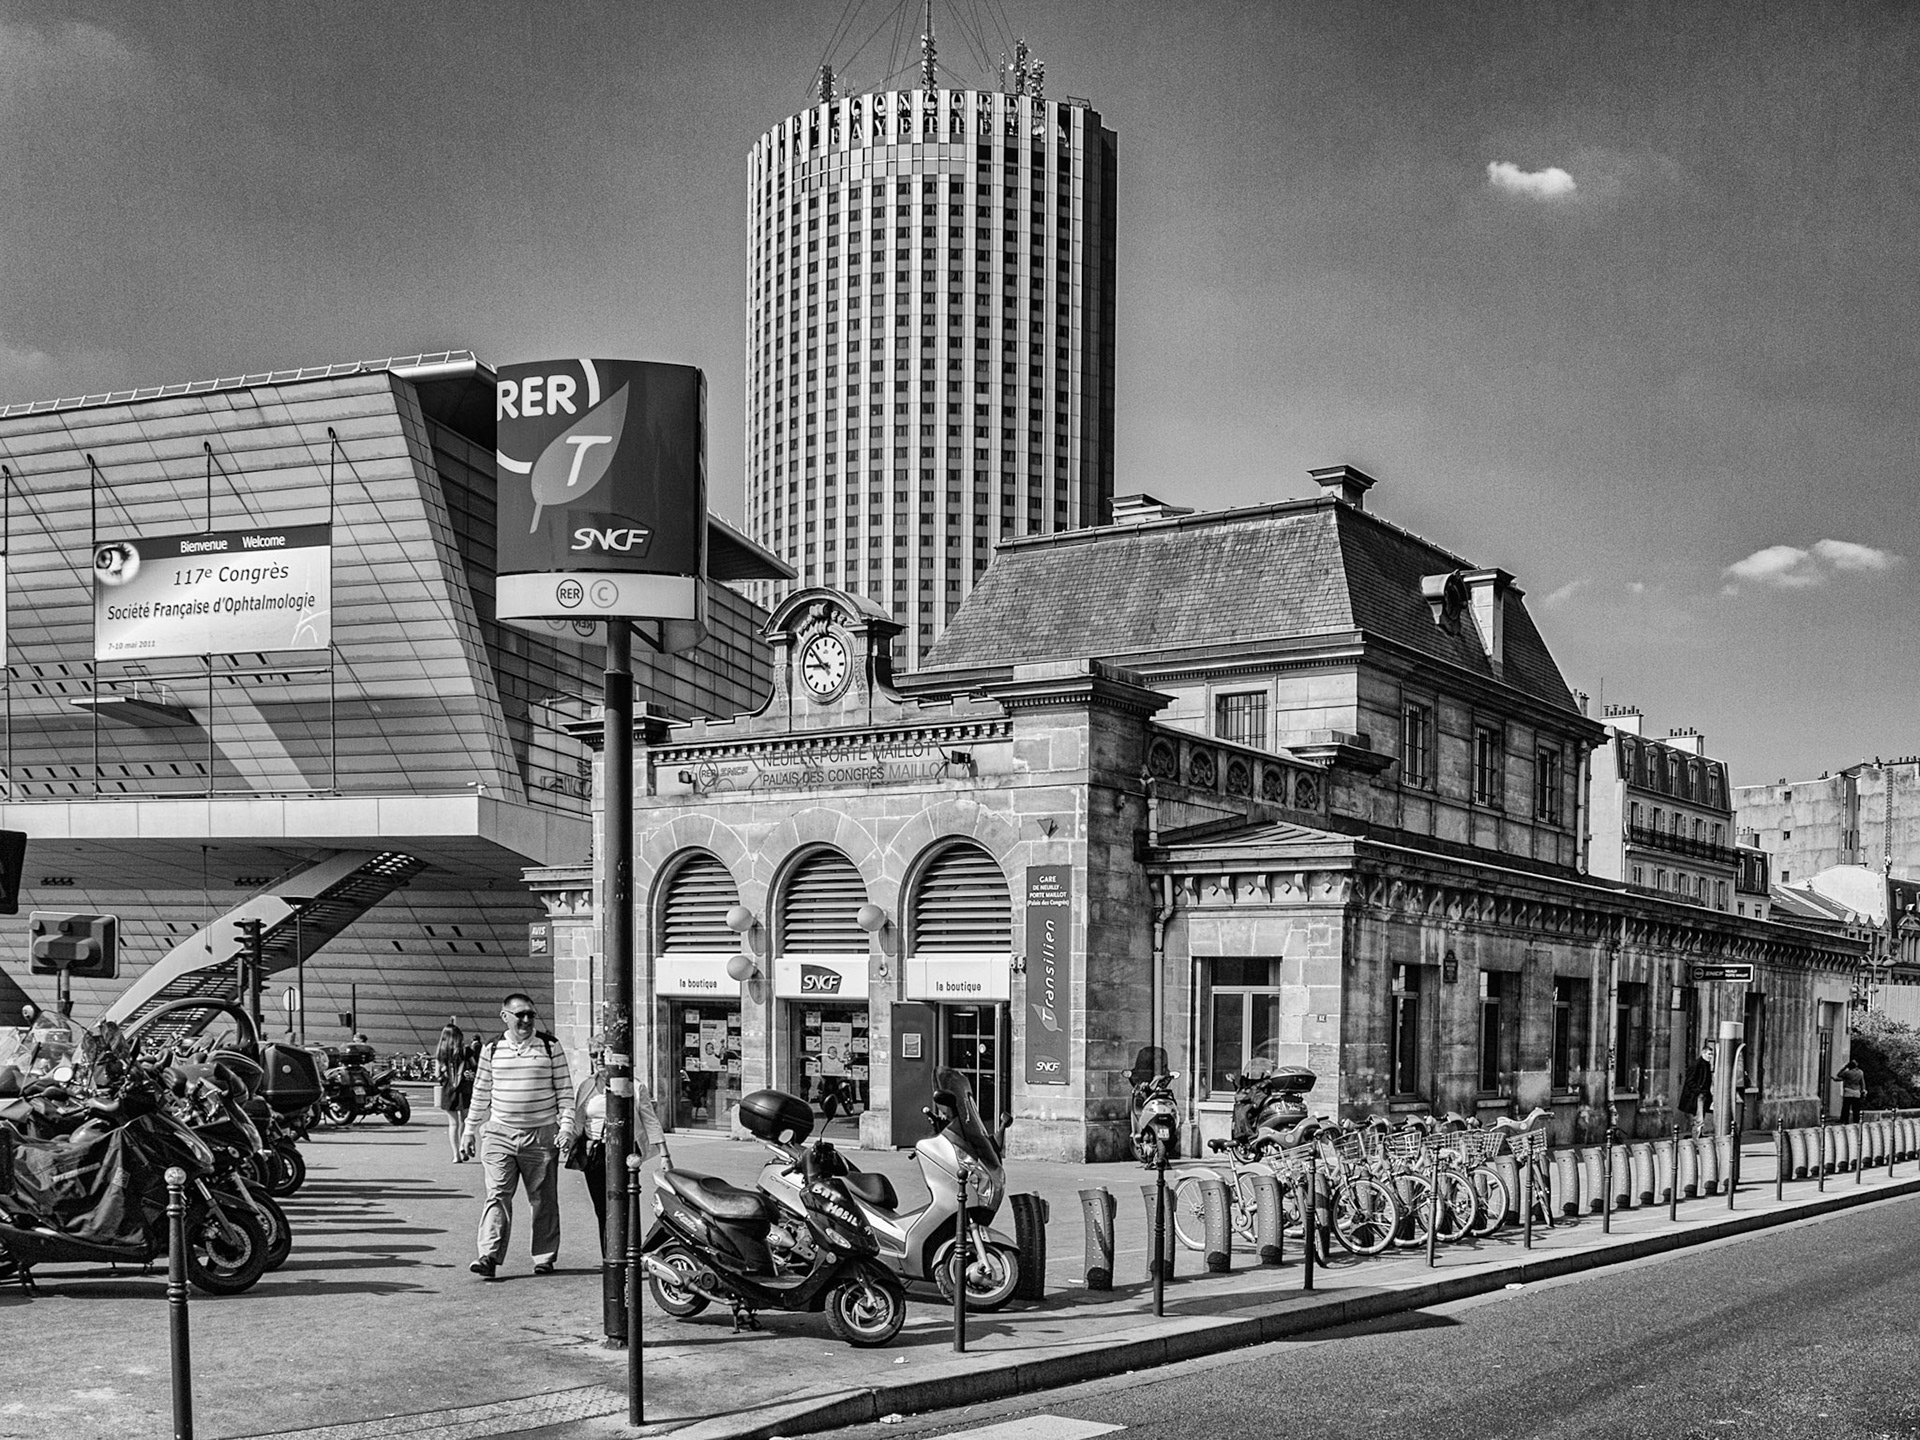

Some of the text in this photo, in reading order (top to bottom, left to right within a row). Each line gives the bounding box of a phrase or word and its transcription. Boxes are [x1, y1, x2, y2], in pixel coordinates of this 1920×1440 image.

[497, 375, 577, 422] RER
[180, 535, 286, 554] Bienvenue Welcome
[571, 527, 649, 551] SNCF
[219, 561, 289, 585] Congrès
[559, 587, 609, 602] RER C
[107, 592, 315, 620] Société Française d'Ophtalmologie
[107, 640, 156, 651] 7-10 mai 2011
[872, 741, 932, 760] MAILLOT
[763, 772, 799, 785] PALAIS
[803, 770, 824, 784] DES
[1043, 919, 1055, 1021] Transilien
[679, 978, 717, 989] la boutique
[803, 975, 840, 990] SNCF
[936, 981, 981, 993] la boutique
[1035, 1061, 1060, 1072] SNCF
[812, 1183, 841, 1201] BAT
